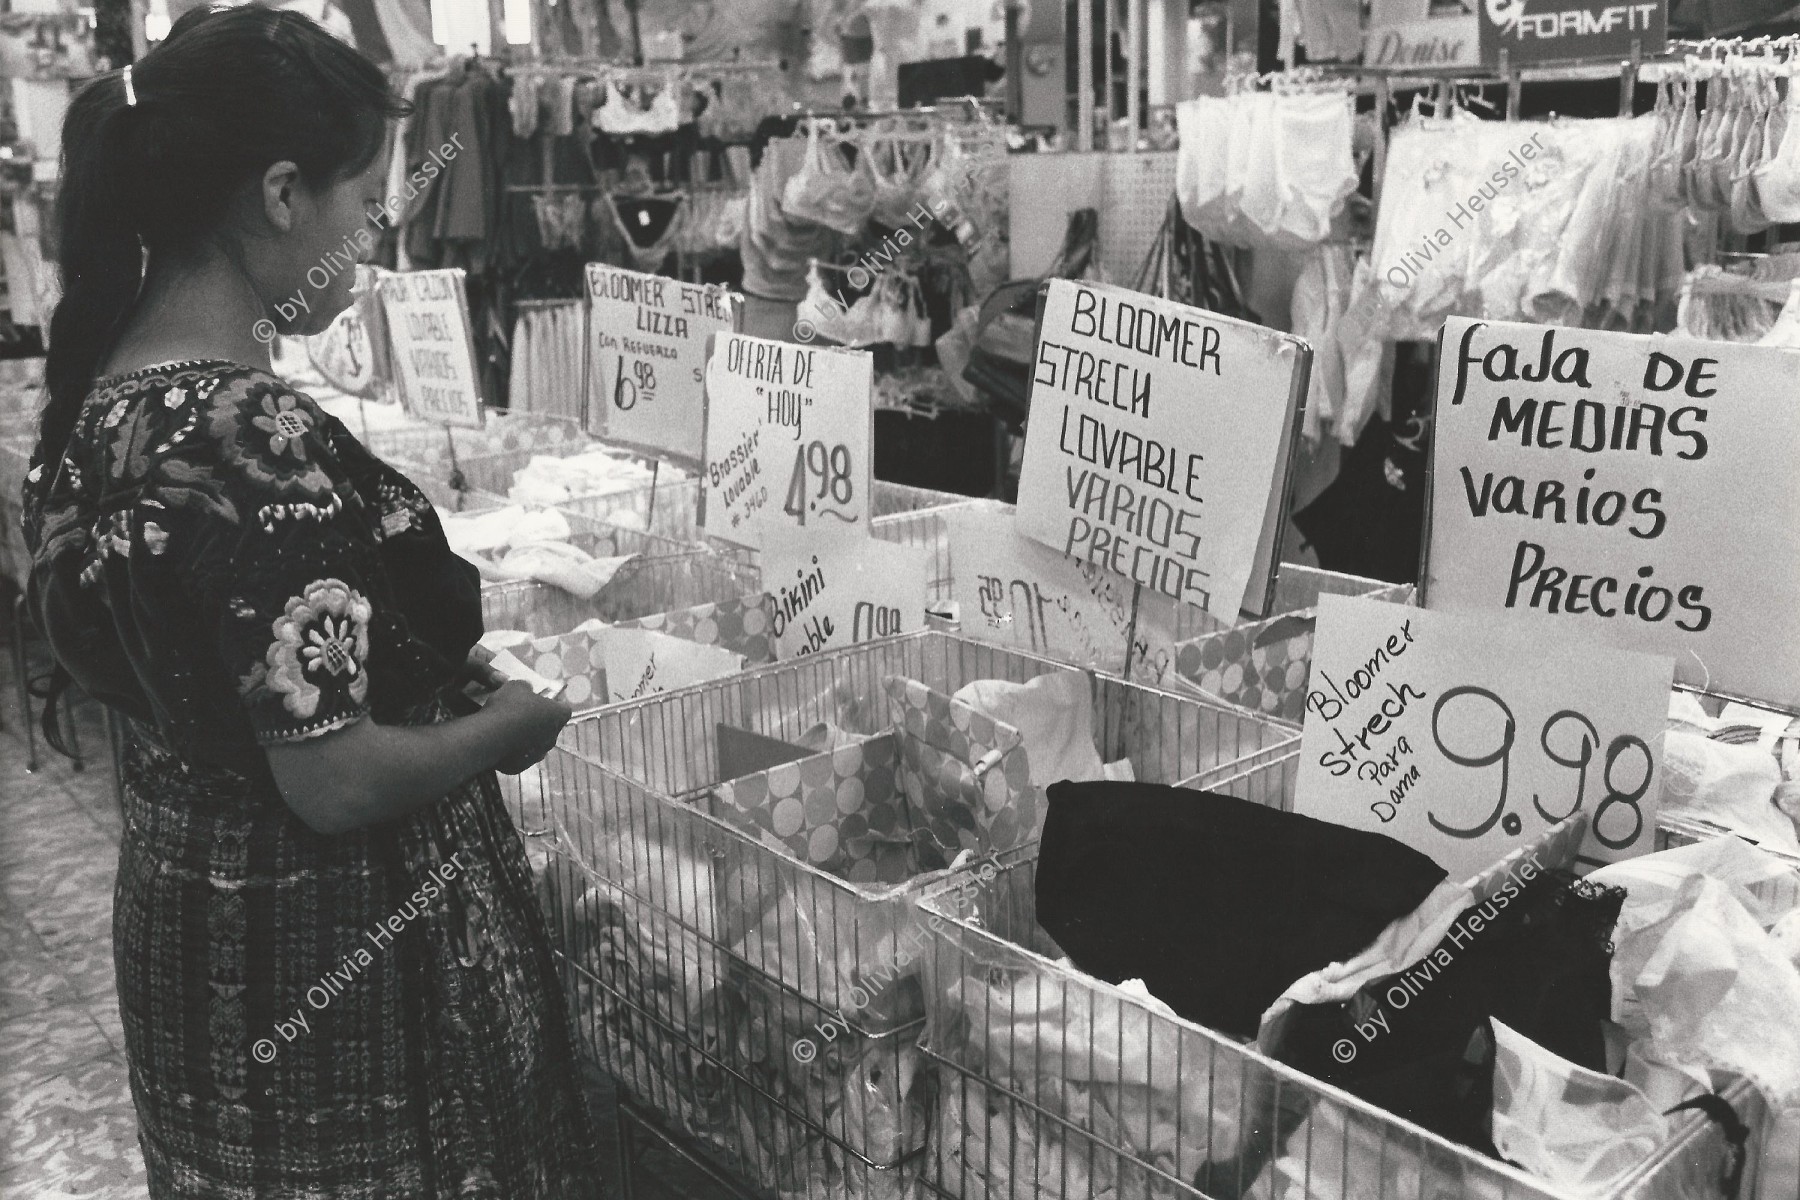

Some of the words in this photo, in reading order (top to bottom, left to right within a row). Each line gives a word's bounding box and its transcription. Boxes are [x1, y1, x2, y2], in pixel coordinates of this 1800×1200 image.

[1516, 3, 1658, 41] FORMFIT
[636, 305, 689, 340] LIZZA
[727, 337, 784, 385] OFERTA
[793, 349, 817, 389] DE
[1070, 289, 1221, 376] BLOOMER
[1035, 340, 1151, 419] STRECH
[1642, 351, 1719, 399] DE
[1060, 404, 1204, 504] LOVABLE
[1487, 395, 1709, 461] MEDIAS
[783, 439, 853, 527] 4.98
[1066, 465, 1202, 560] VARIOS
[1064, 516, 1211, 613] PRECIOS
[1306, 618, 1416, 722] Bloomer
[1319, 681, 1427, 777] Strech
[1357, 735, 1414, 786] Para
[1427, 685, 1654, 851] 9.98
[1370, 763, 1422, 824] Dama
